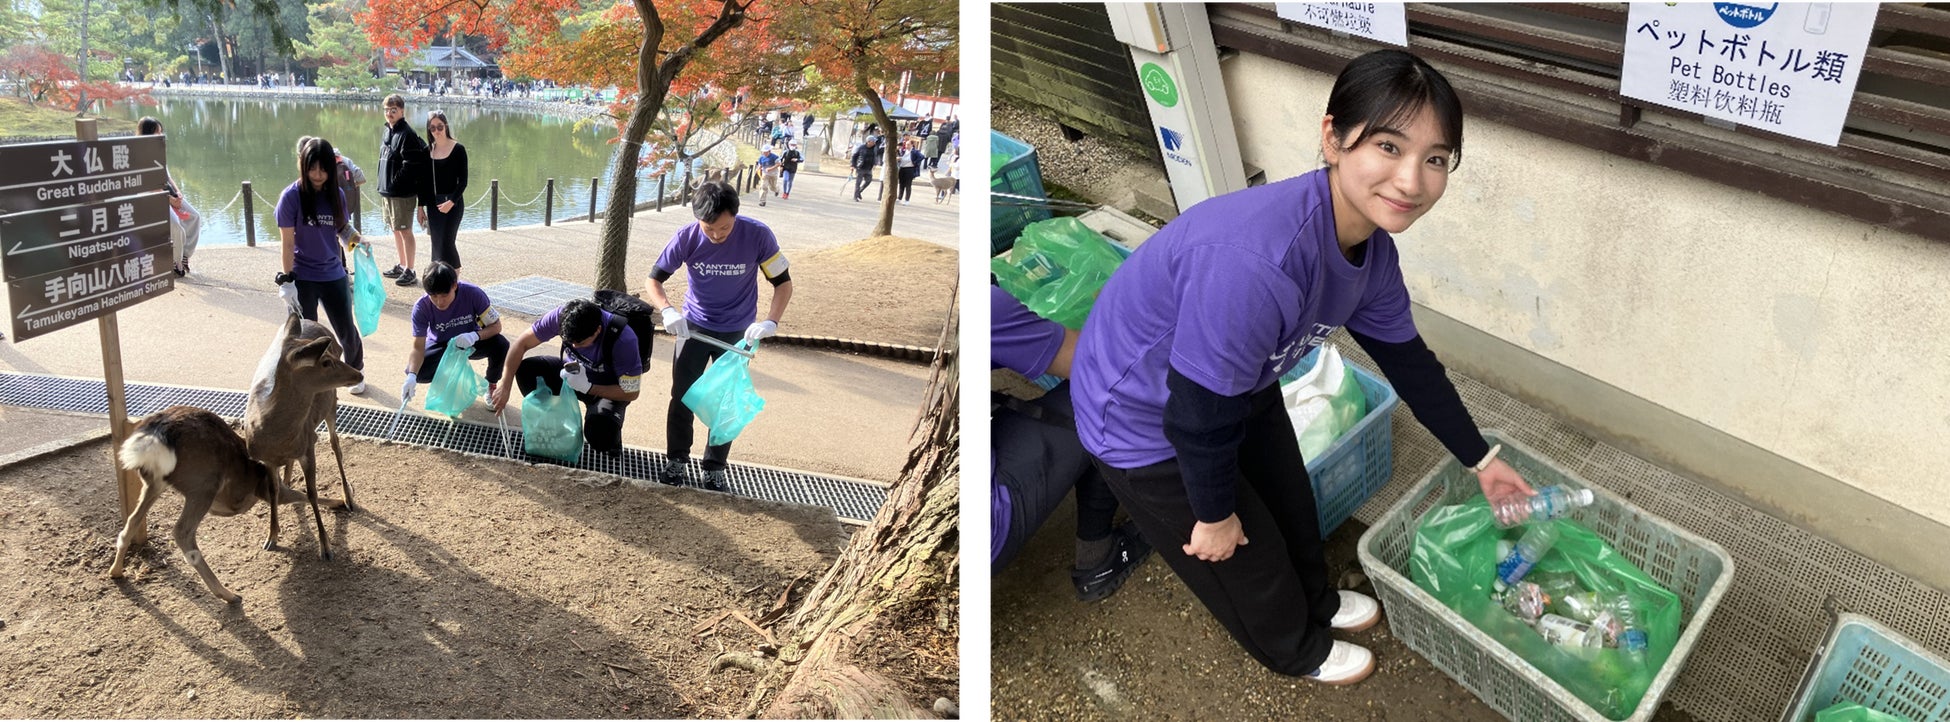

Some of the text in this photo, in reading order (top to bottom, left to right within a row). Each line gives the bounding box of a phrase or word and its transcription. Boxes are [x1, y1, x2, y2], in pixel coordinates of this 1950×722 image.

[1719, 6, 1764, 22] ペットボトル
[1637, 19, 1848, 84] ペットボトル類
[1670, 57, 1791, 98] Pet Bottles
[1668, 79, 1785, 125] 塑料饮料瓶
[51, 145, 130, 177] 大仏殿
[37, 175, 142, 200] Great Buddha Hall
[59, 204, 135, 237] 二月堂
[69, 236, 130, 258] Nigatsu-do
[45, 254, 154, 303] 手向山八幡宮
[24, 279, 168, 330] Tamukeyama Hachiman Shrine
